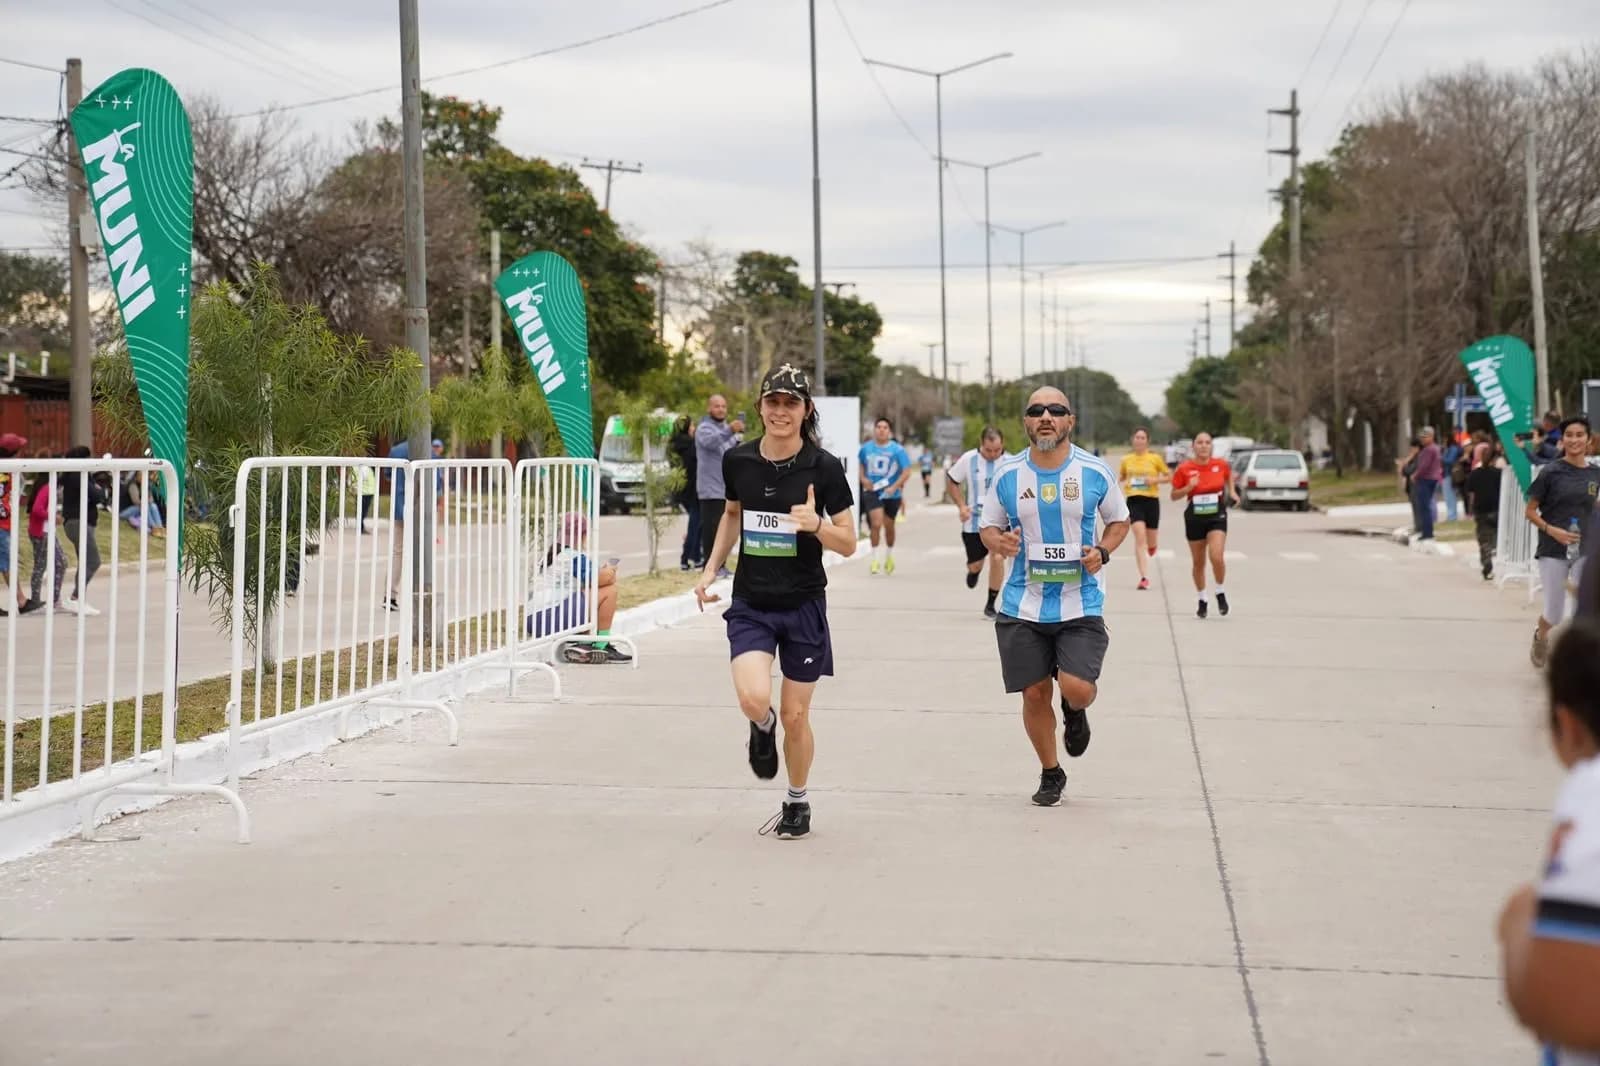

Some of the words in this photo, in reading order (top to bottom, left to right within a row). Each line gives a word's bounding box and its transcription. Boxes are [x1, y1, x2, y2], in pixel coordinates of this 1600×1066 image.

[82, 126, 156, 325] MUNI
[505, 286, 566, 395] MUNI
[1466, 356, 1514, 426] MUNI
[866, 454, 889, 474] 10
[756, 514, 779, 528] 706
[1044, 547, 1066, 560] 536
